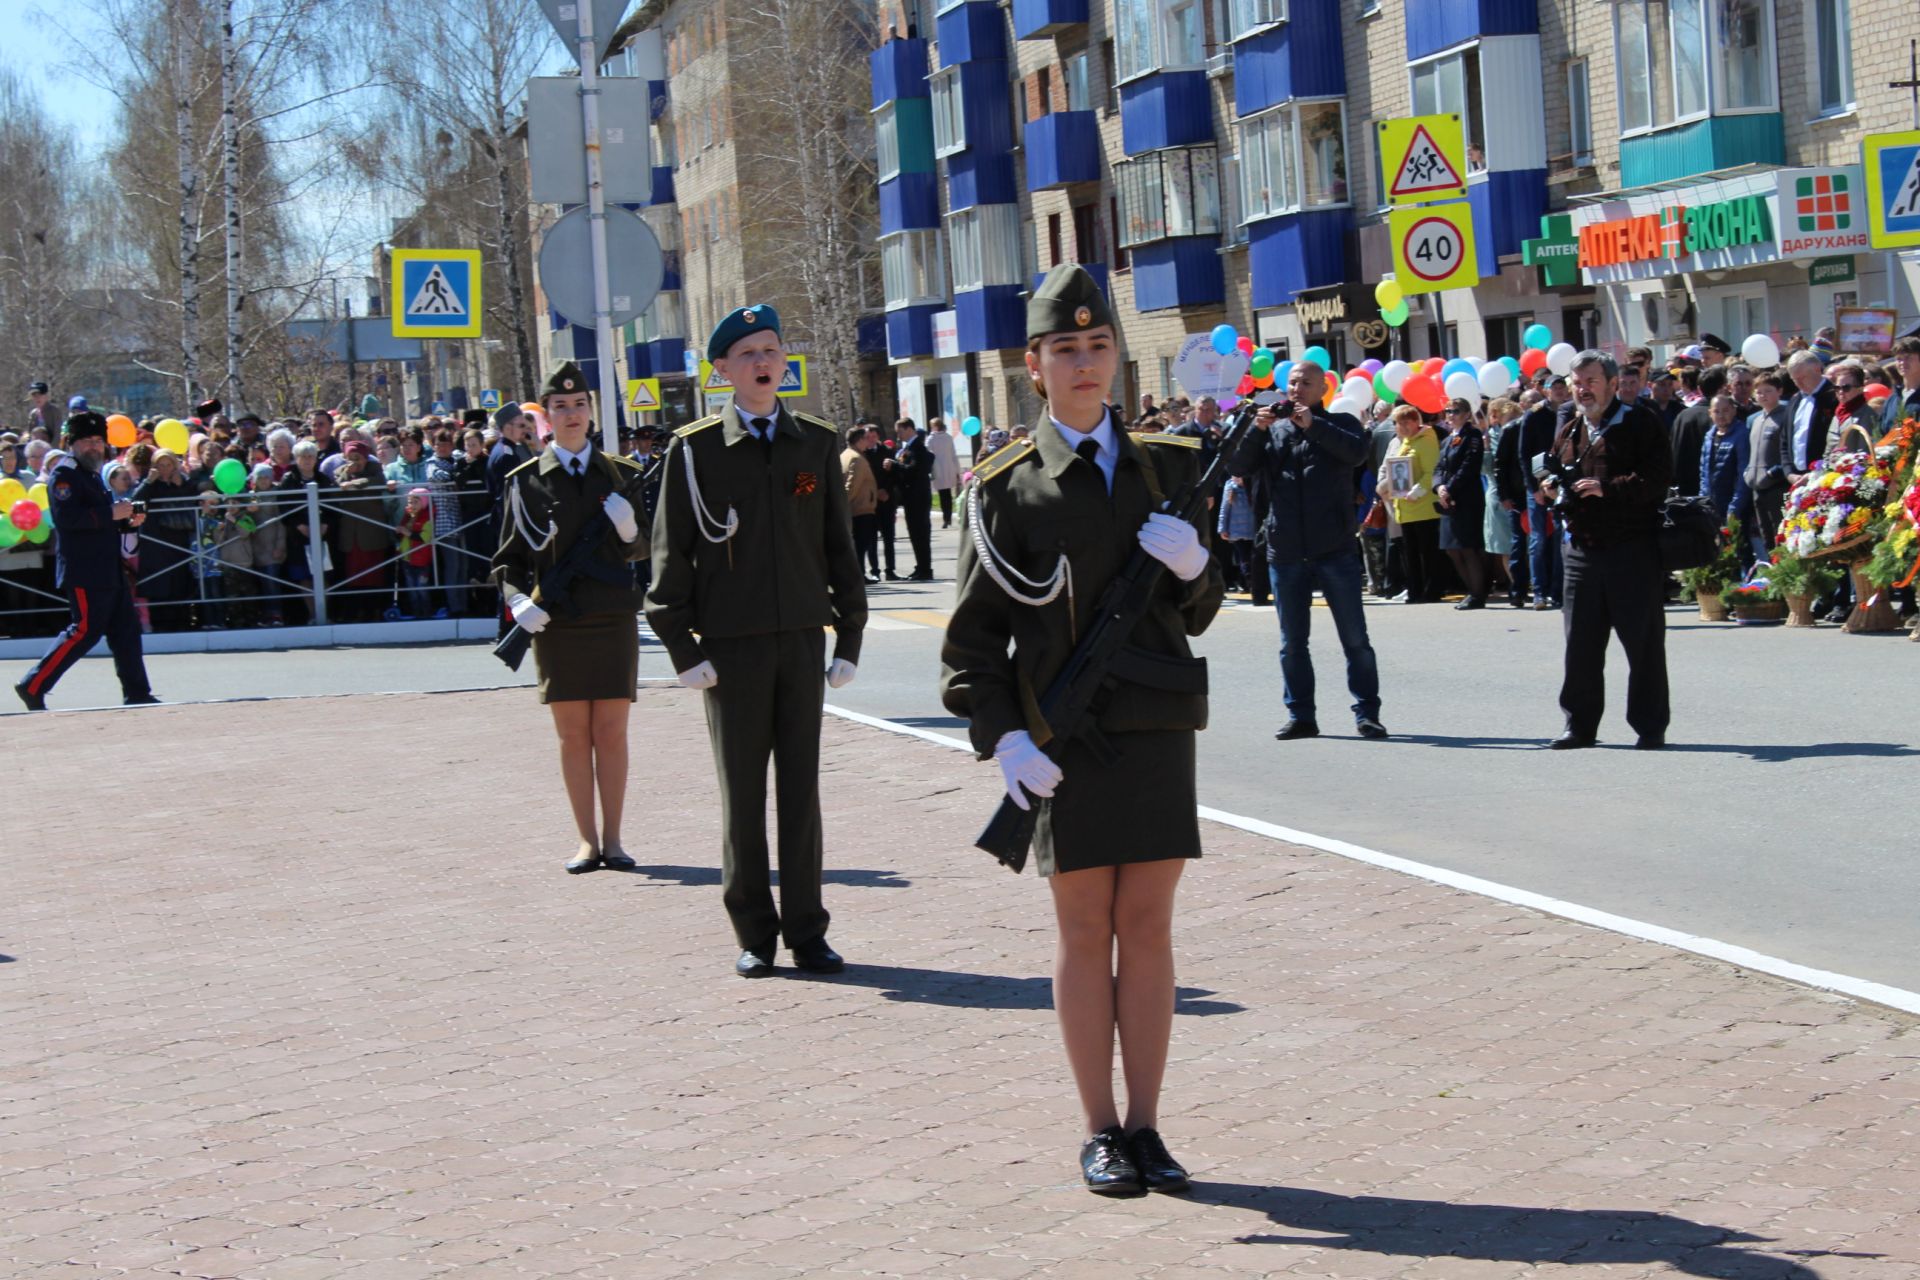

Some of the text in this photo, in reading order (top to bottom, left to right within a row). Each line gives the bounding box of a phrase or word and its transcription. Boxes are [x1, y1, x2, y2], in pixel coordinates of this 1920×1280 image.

[1578, 196, 1766, 269] АПТЕКА ЭКОНА
[1781, 233, 1868, 255] ДАРУХАНӘ
[1415, 235, 1452, 262] 40
[1536, 244, 1579, 258] АПТЕК
